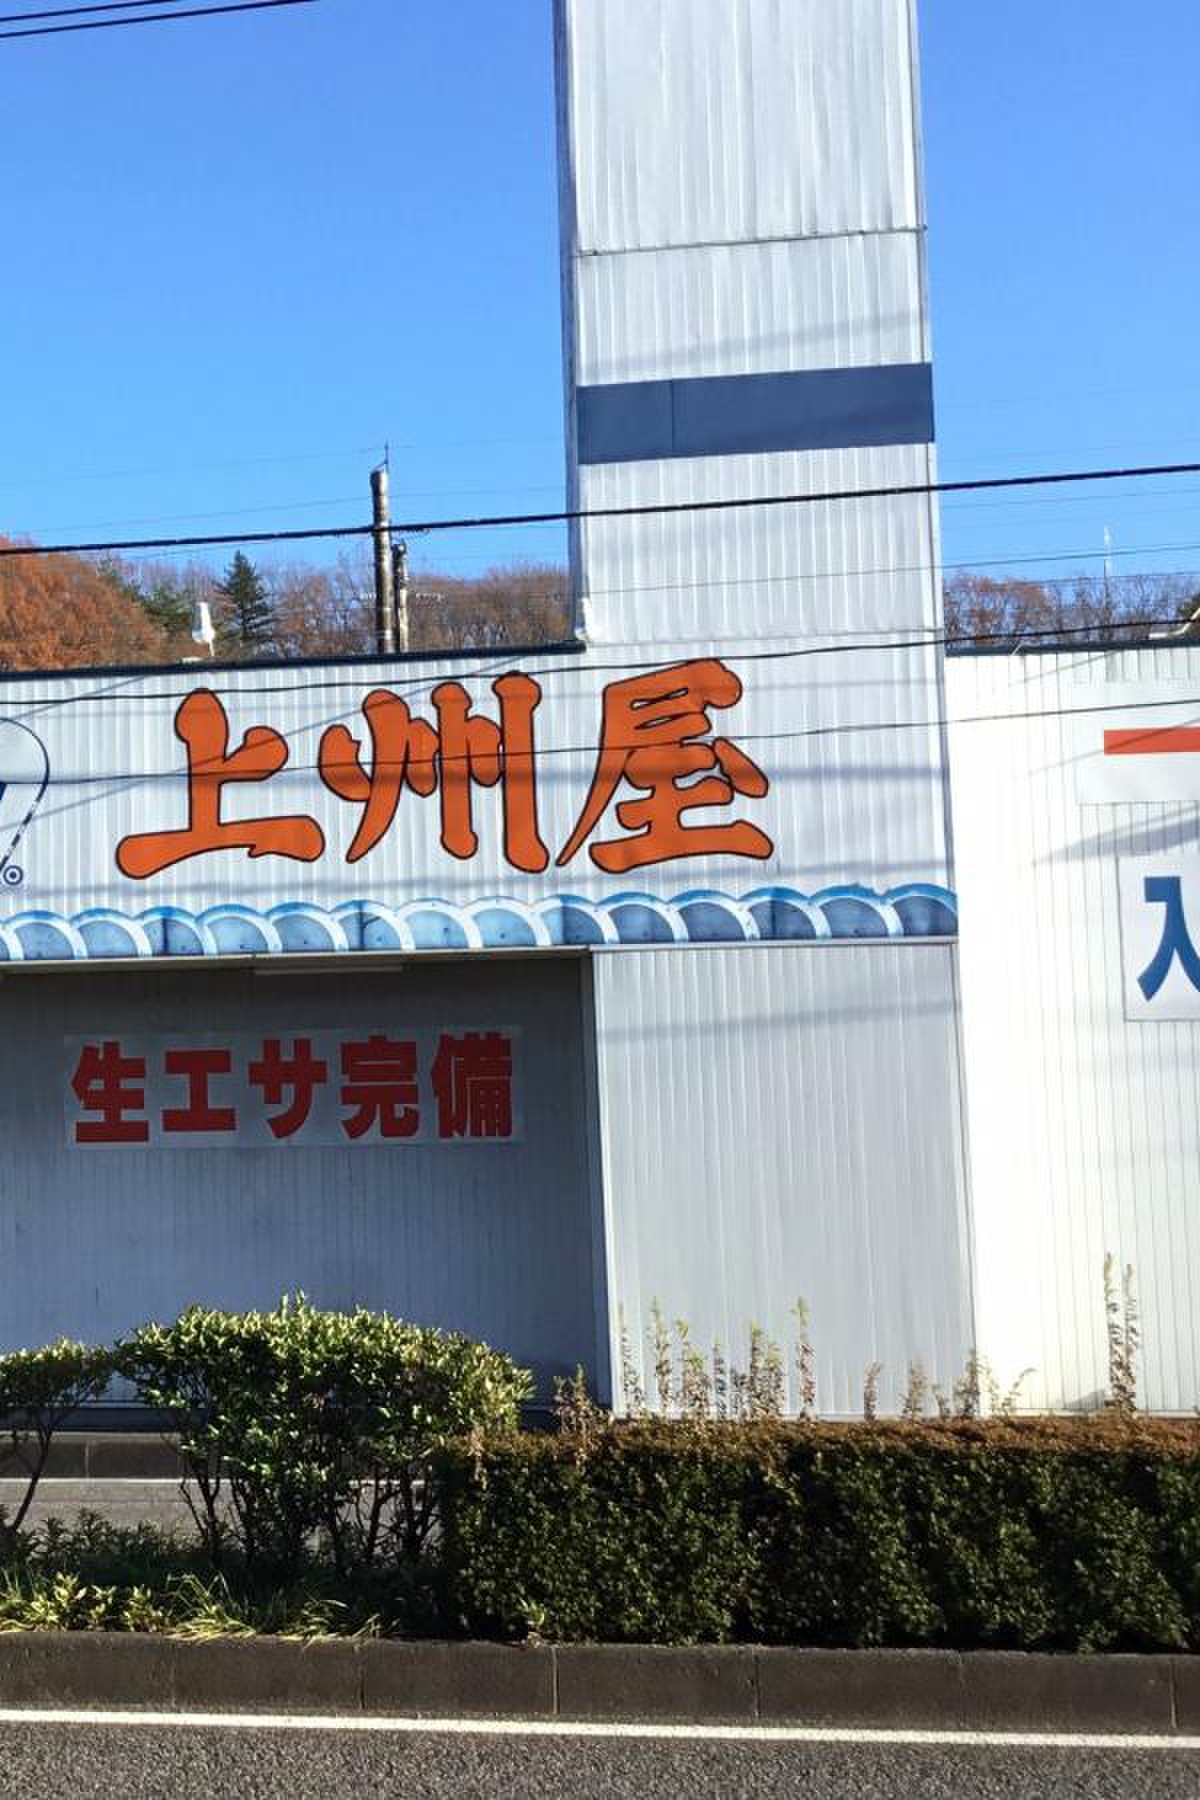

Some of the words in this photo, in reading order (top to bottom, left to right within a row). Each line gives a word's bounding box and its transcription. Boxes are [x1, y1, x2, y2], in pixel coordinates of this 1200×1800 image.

[116, 657, 774, 879] 上州屋
[71, 1031, 514, 1144] 生エサ完備
